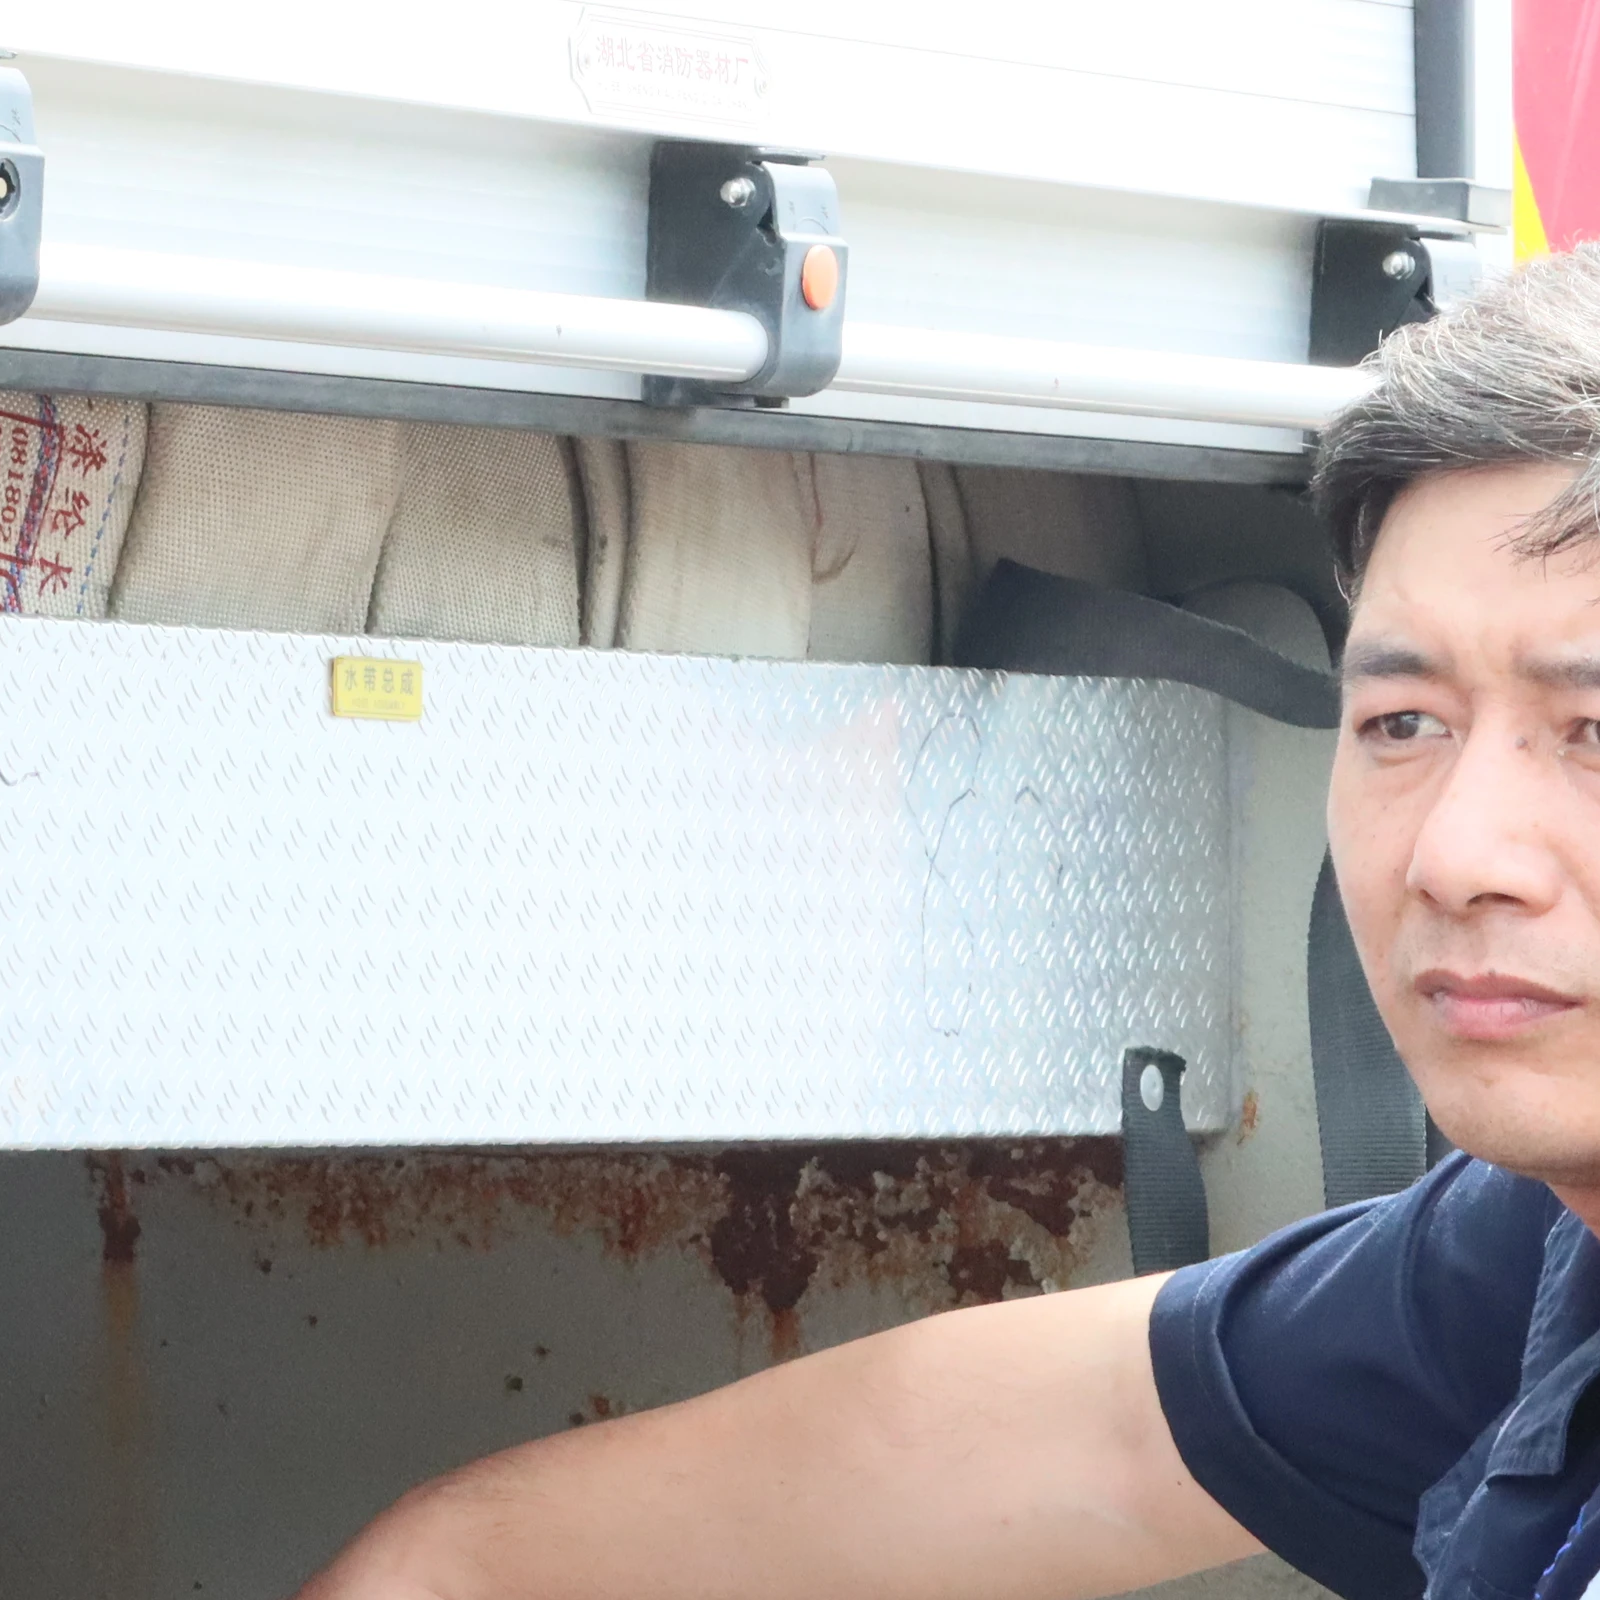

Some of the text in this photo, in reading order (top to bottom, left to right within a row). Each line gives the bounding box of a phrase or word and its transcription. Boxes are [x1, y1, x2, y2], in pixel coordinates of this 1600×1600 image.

[594, 33, 750, 86] 湖北省消防器材厂
[36, 423, 109, 596] 涤纶长
[344, 664, 415, 697] 水带总成
